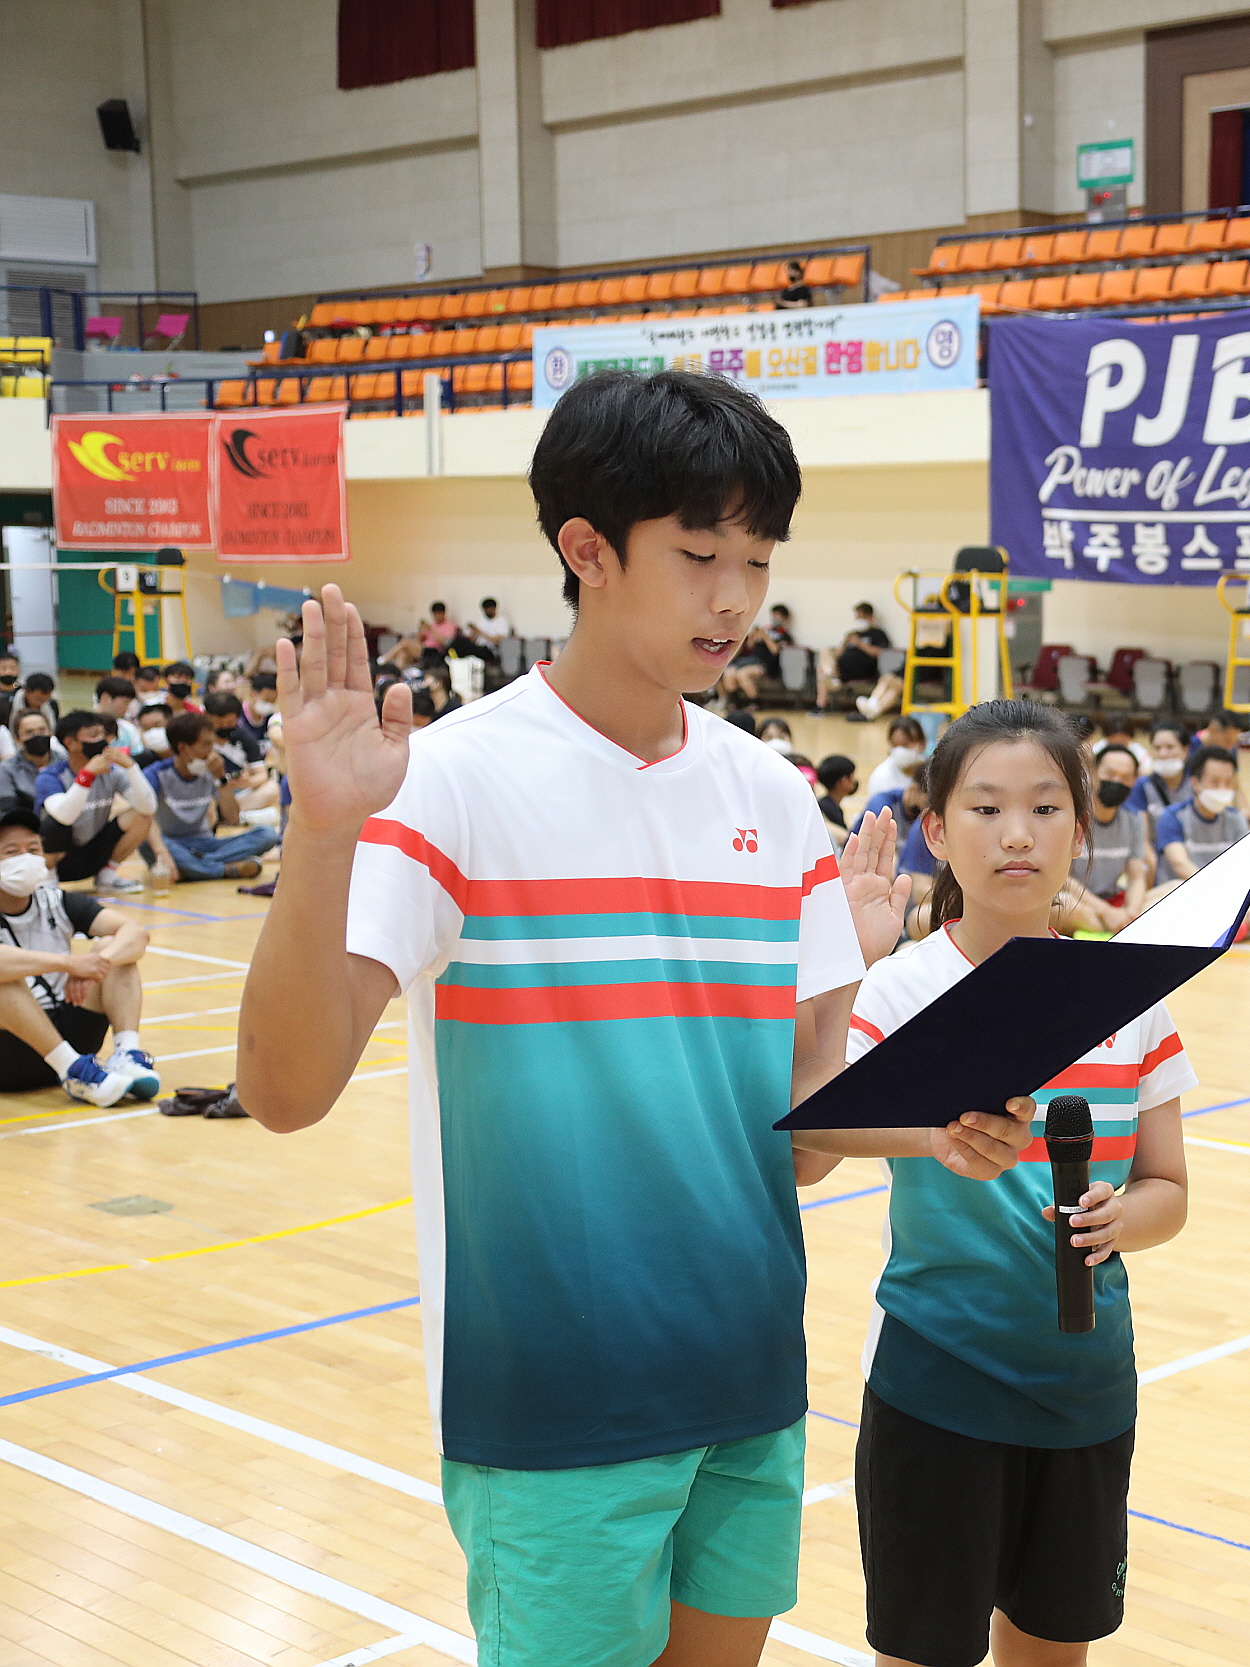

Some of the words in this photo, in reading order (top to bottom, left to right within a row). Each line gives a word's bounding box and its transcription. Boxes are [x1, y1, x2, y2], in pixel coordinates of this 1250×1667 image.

[767, 346, 818, 377] 오신걸
[824, 338, 922, 375] 환영합니다
[934, 330, 954, 359] 영
[1038, 445, 1142, 504] Power
